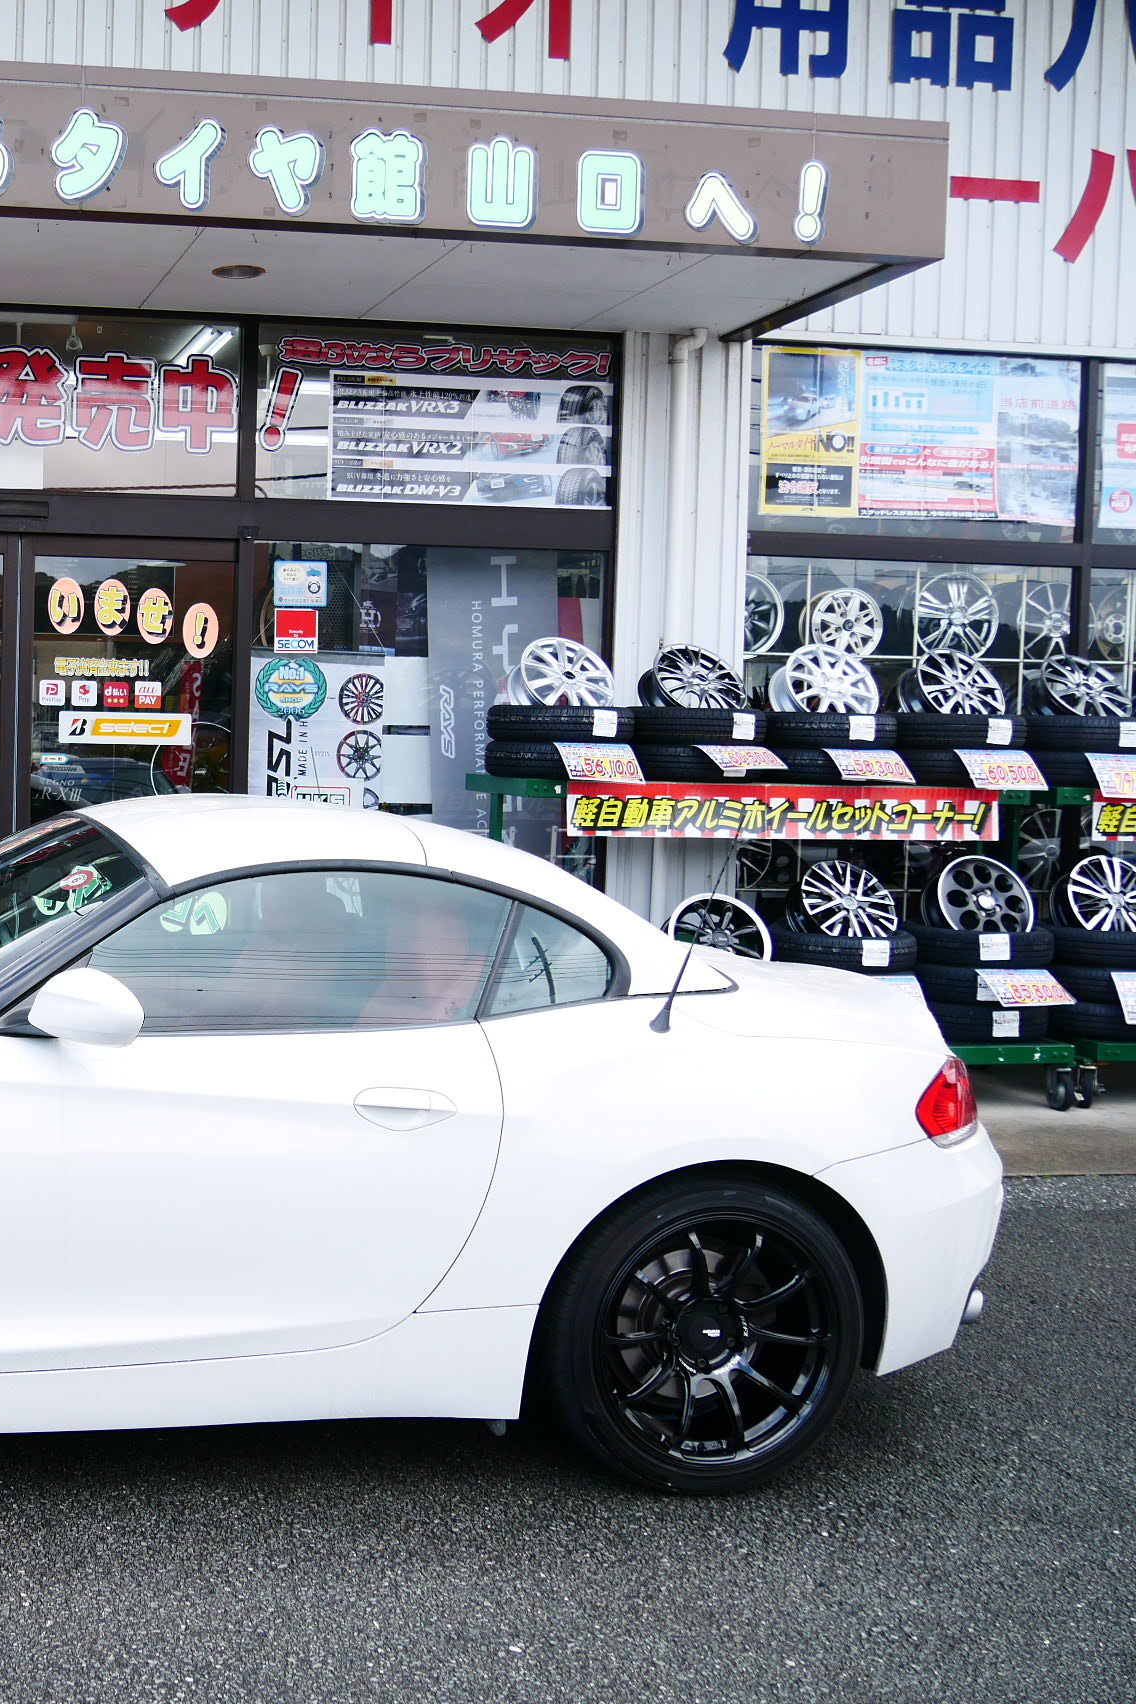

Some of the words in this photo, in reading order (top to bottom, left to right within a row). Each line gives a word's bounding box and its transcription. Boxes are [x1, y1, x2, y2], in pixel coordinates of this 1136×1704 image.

[336, 400, 409, 412] BLIZZAK
[409, 400, 460, 414] VRX3
[336, 440, 410, 453] BLIZZAK
[410, 441, 463, 455] VRX2
[336, 484, 404, 495] BLIZZAK
[404, 484, 462, 498] DM-V3
[471, 600, 484, 673] HOMURA
[278, 639, 314, 649] SECOM
[264, 682, 319, 695] RAYS
[138, 695, 157, 705] PAY
[278, 706, 305, 715] 2006
[98, 722, 172, 735] select
[439, 684, 456, 760] RAYS
[572, 794, 990, 834] 軽自動車アルミホイールセットコーナー！
